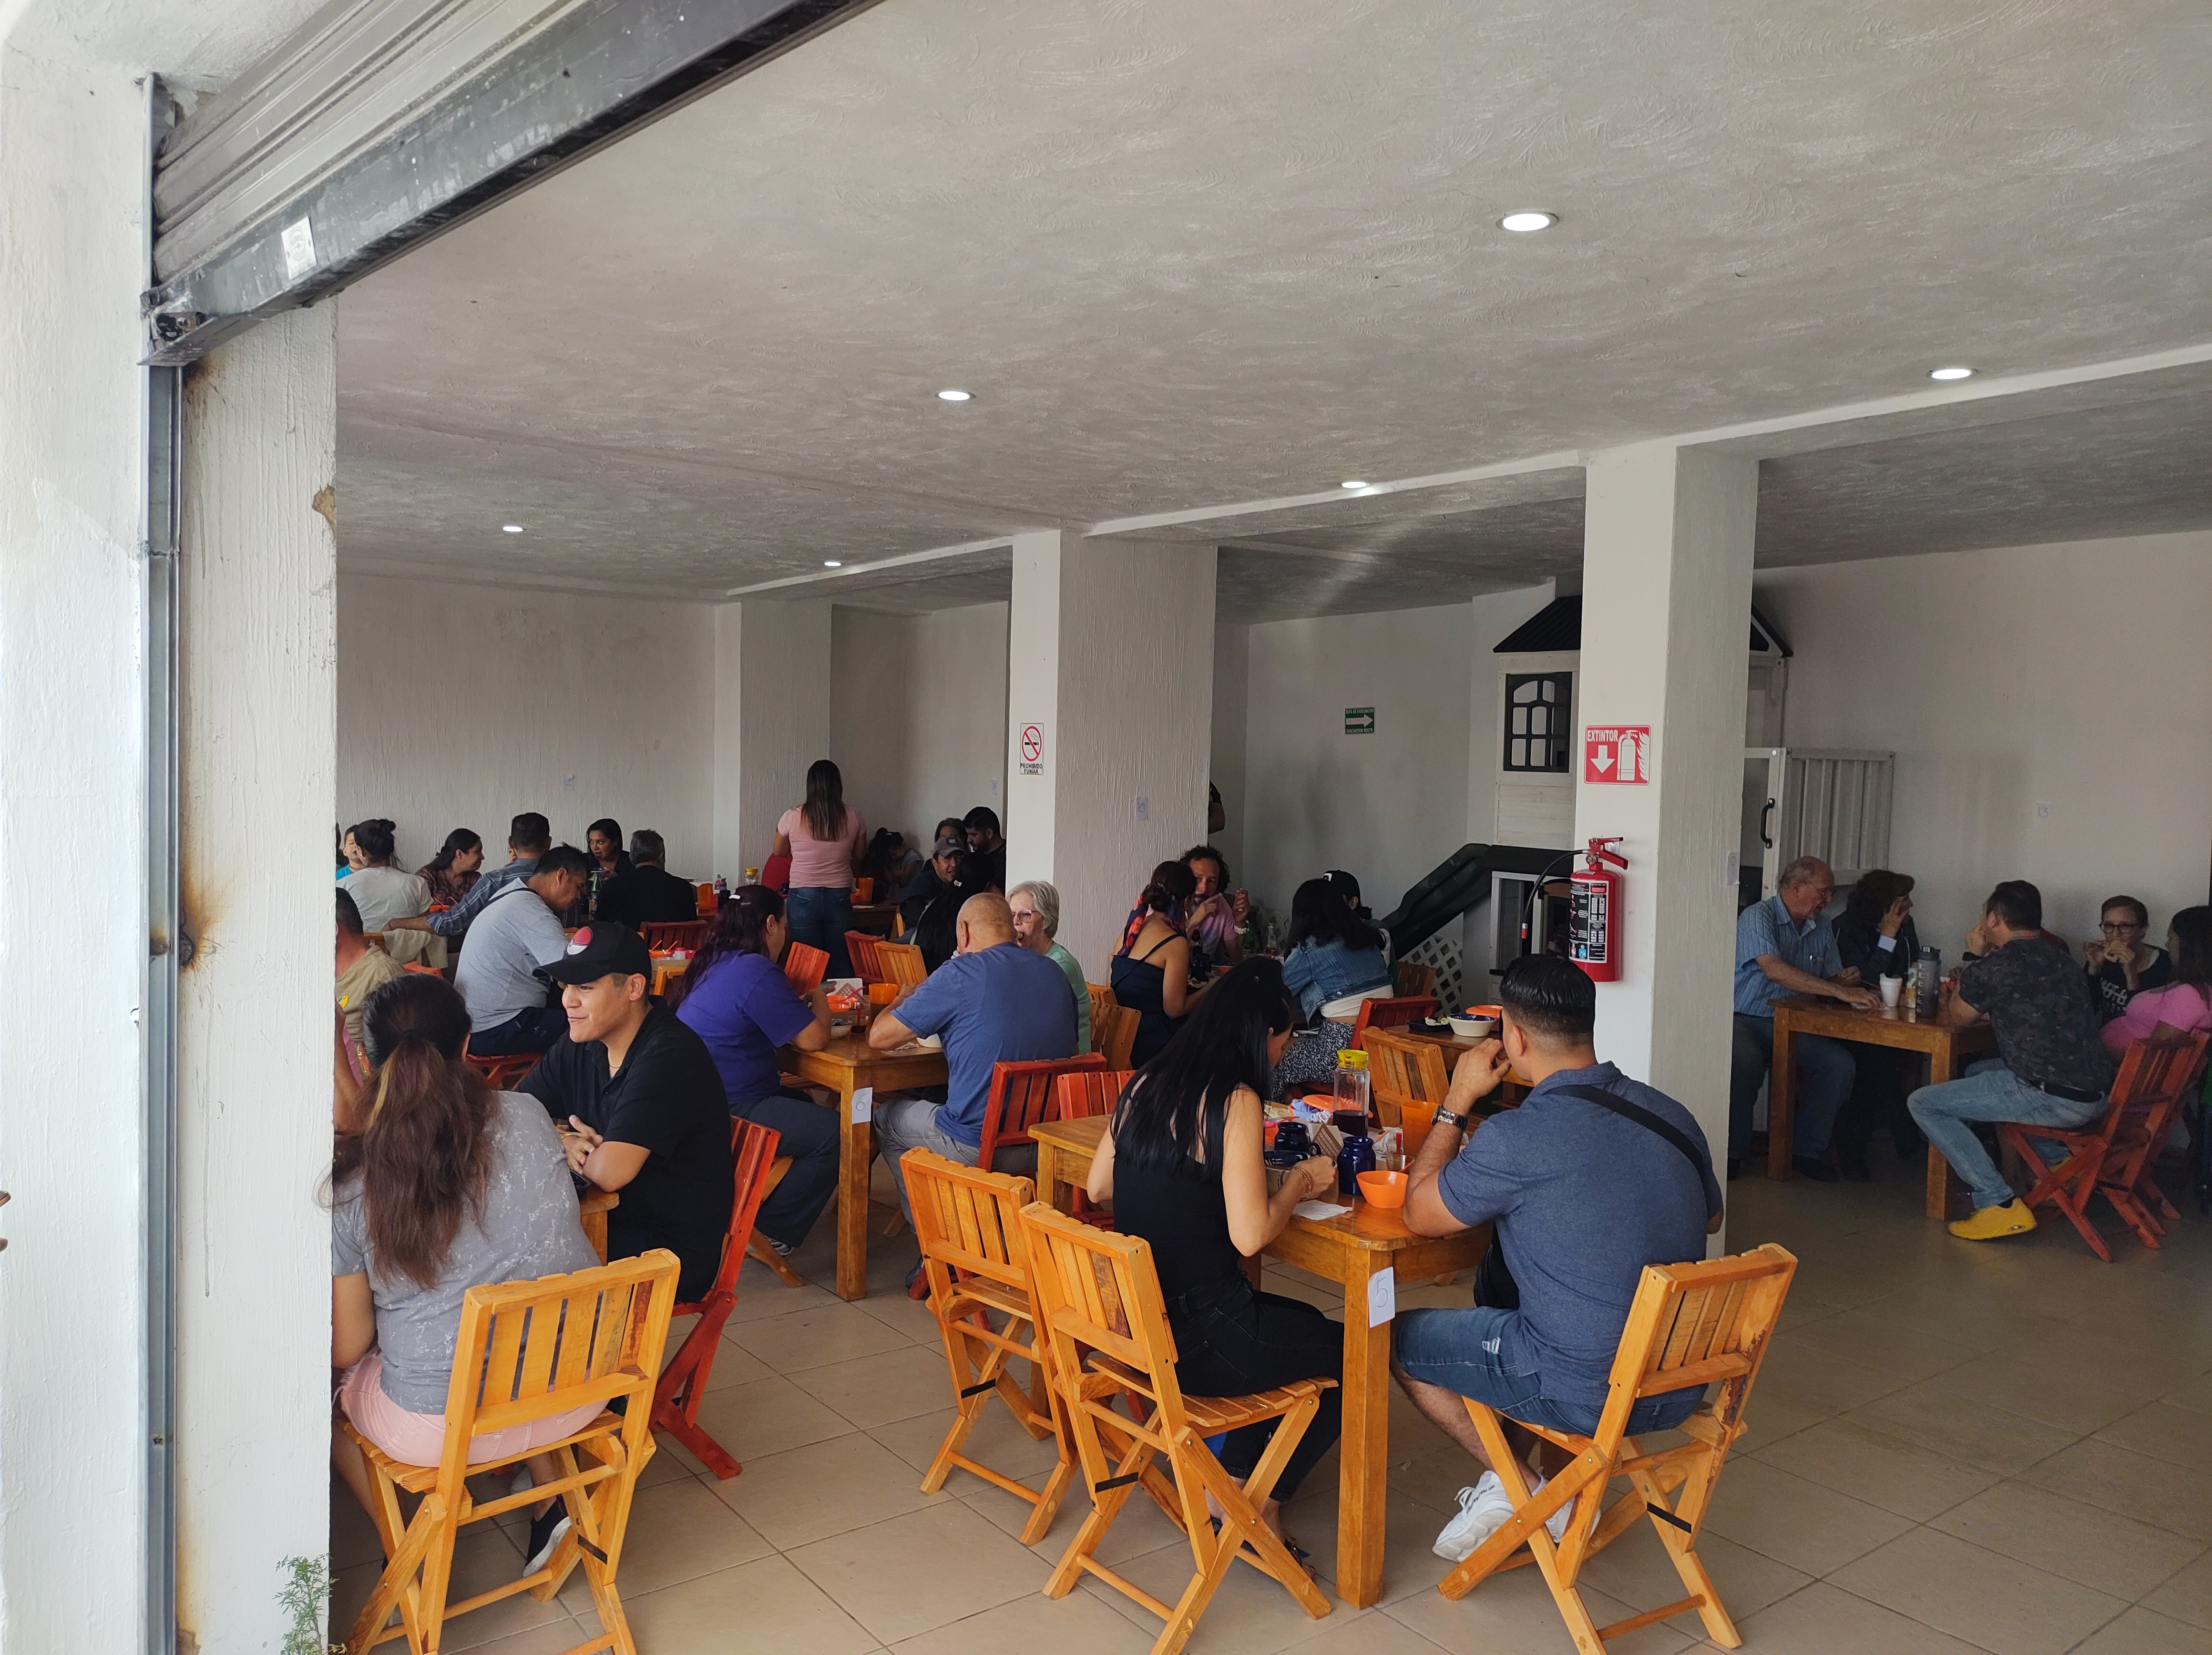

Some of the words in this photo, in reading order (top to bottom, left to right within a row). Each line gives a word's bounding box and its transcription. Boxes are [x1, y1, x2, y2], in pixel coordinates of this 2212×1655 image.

[1587, 729, 1618, 742] EXTINTOR
[1137, 802, 1146, 813] 10
[856, 1093, 866, 1111] 6
[1376, 1276, 1388, 1308] 5
